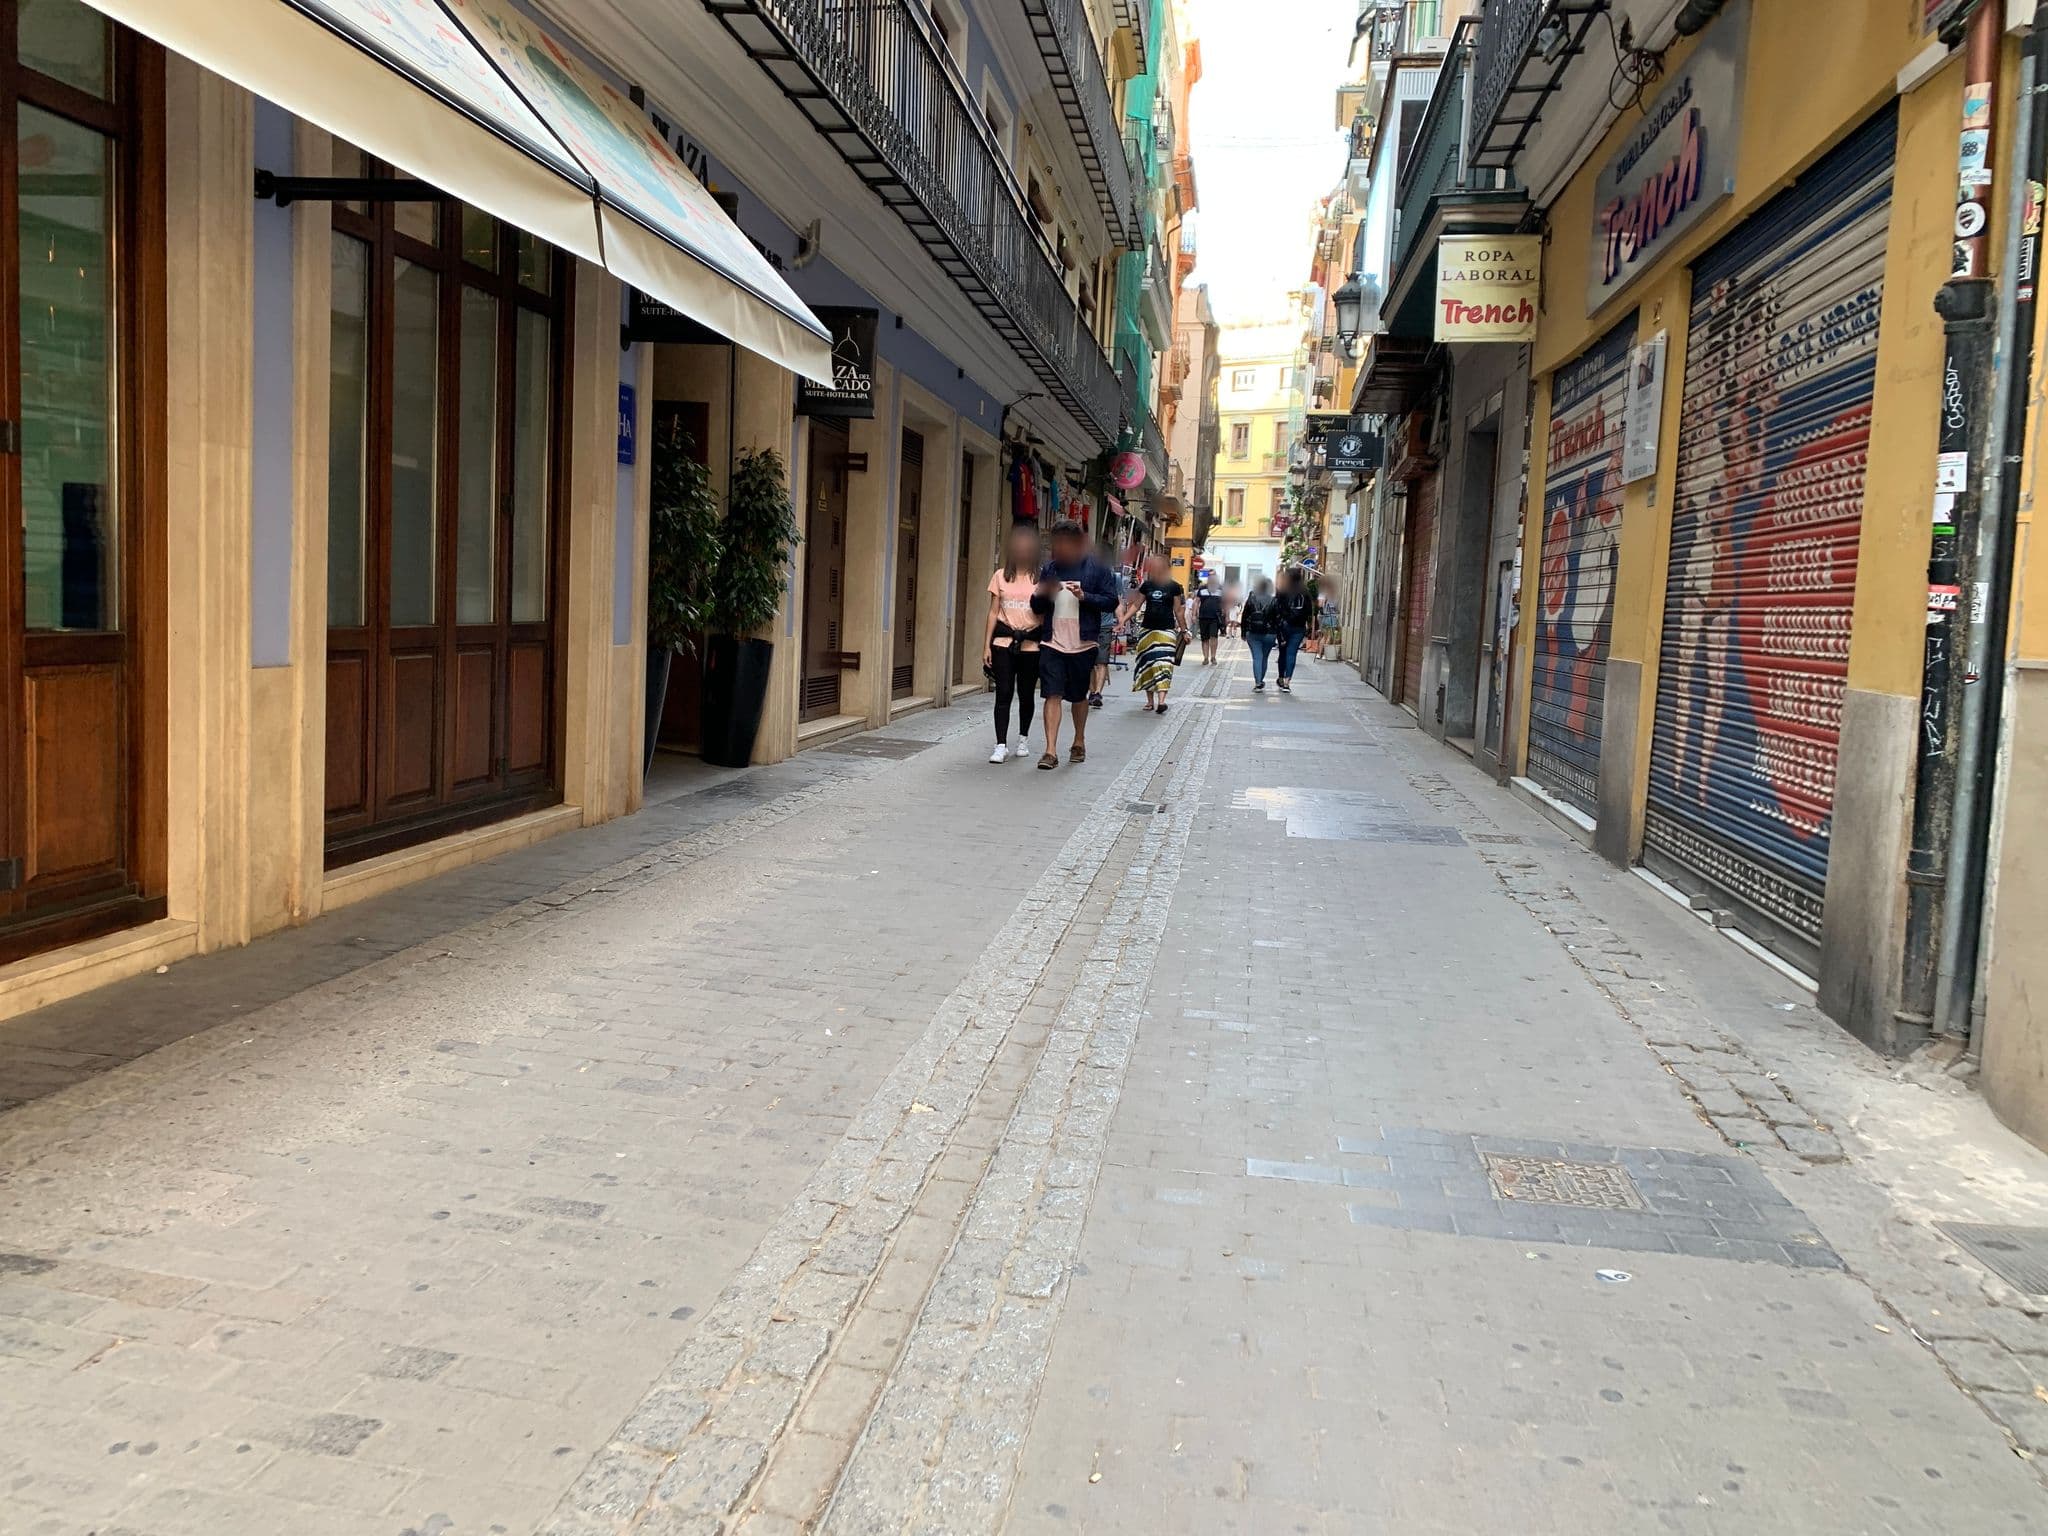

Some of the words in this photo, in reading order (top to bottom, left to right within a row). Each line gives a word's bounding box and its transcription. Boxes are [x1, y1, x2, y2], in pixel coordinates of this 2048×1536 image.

[1465, 250, 1515, 262] ROPA
[1442, 269, 1536, 281] LABORAL
[1440, 297, 1534, 324] Trench
[804, 377, 870, 391] MECADO
